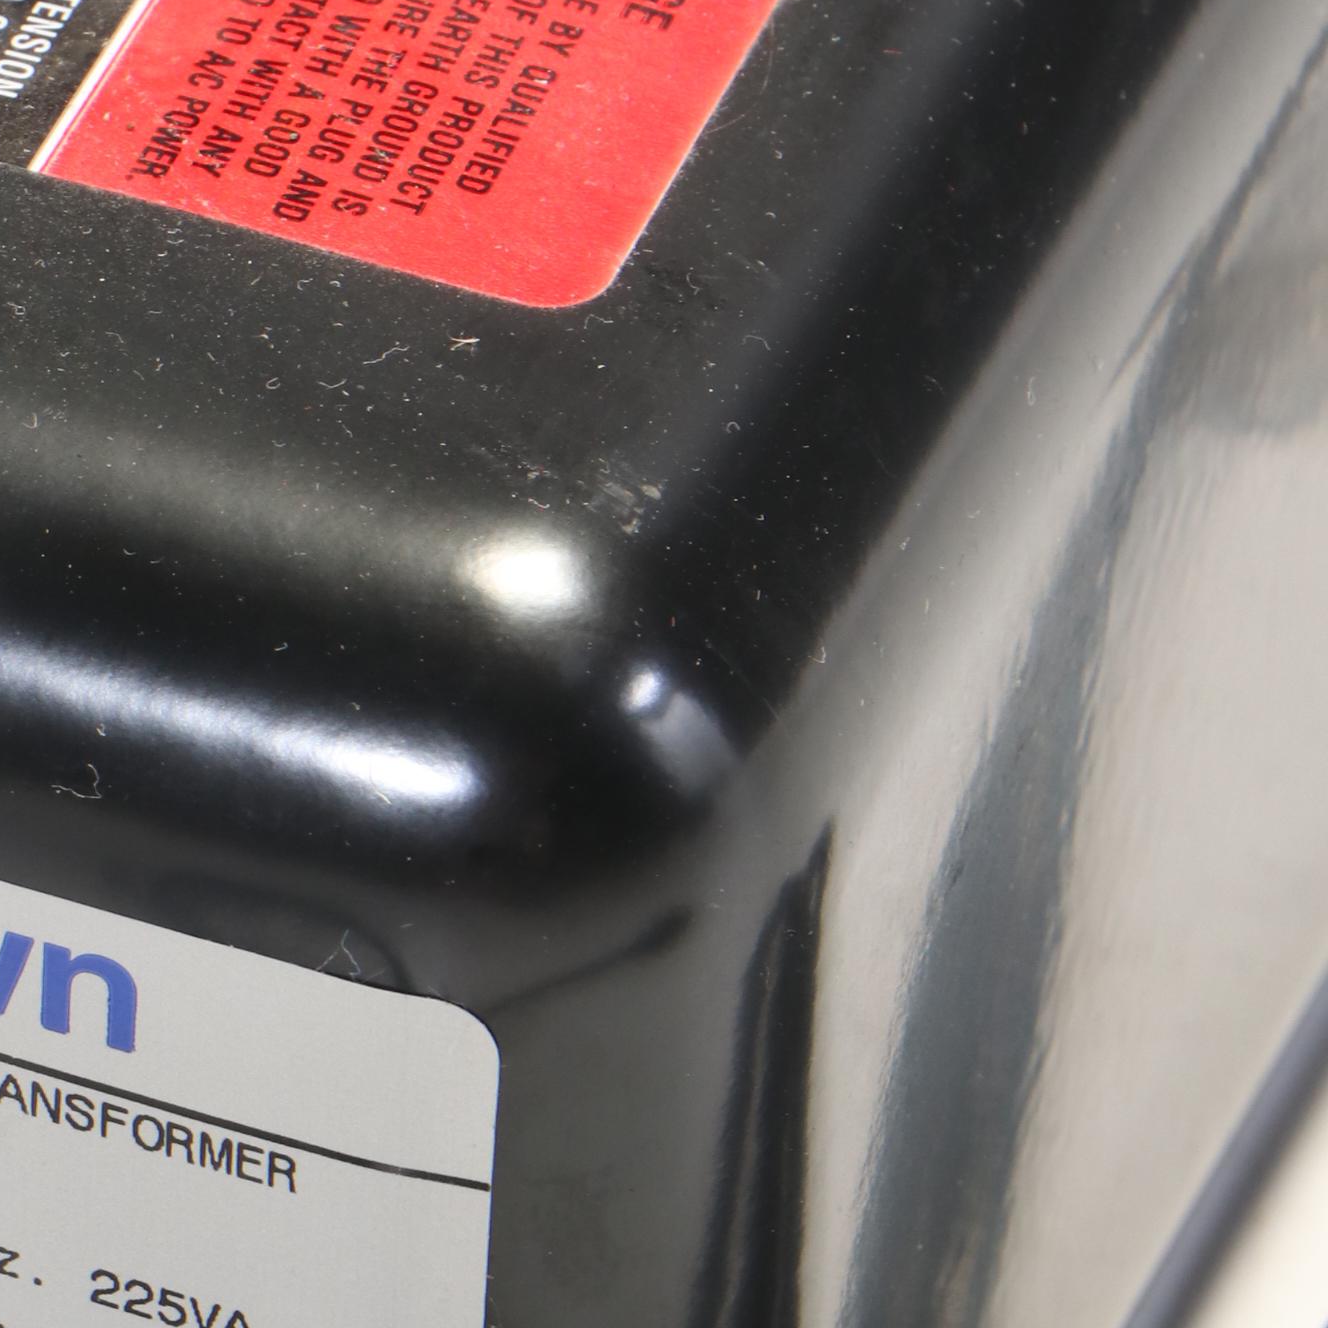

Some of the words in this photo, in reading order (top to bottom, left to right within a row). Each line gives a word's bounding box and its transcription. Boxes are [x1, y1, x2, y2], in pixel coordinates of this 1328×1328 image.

[214, 14, 262, 46] TO
[302, 13, 371, 77] WITH
[537, 21, 583, 56] BY
[184, 49, 237, 91] A/C
[221, 57, 289, 121] WITH
[349, 45, 407, 93] THE
[462, 31, 525, 89] THIS
[286, 81, 327, 101] A
[122, 94, 210, 183] POWER.
[187, 125, 245, 178] ANY
[241, 108, 312, 178] GOOD
[305, 98, 374, 164] PLUG
[349, 79, 439, 183] GROUND
[386, 96, 486, 215] PRODUCT
[452, 64, 558, 195] QUALIFIED
[270, 169, 330, 223] AND
[329, 188, 373, 216] IS
